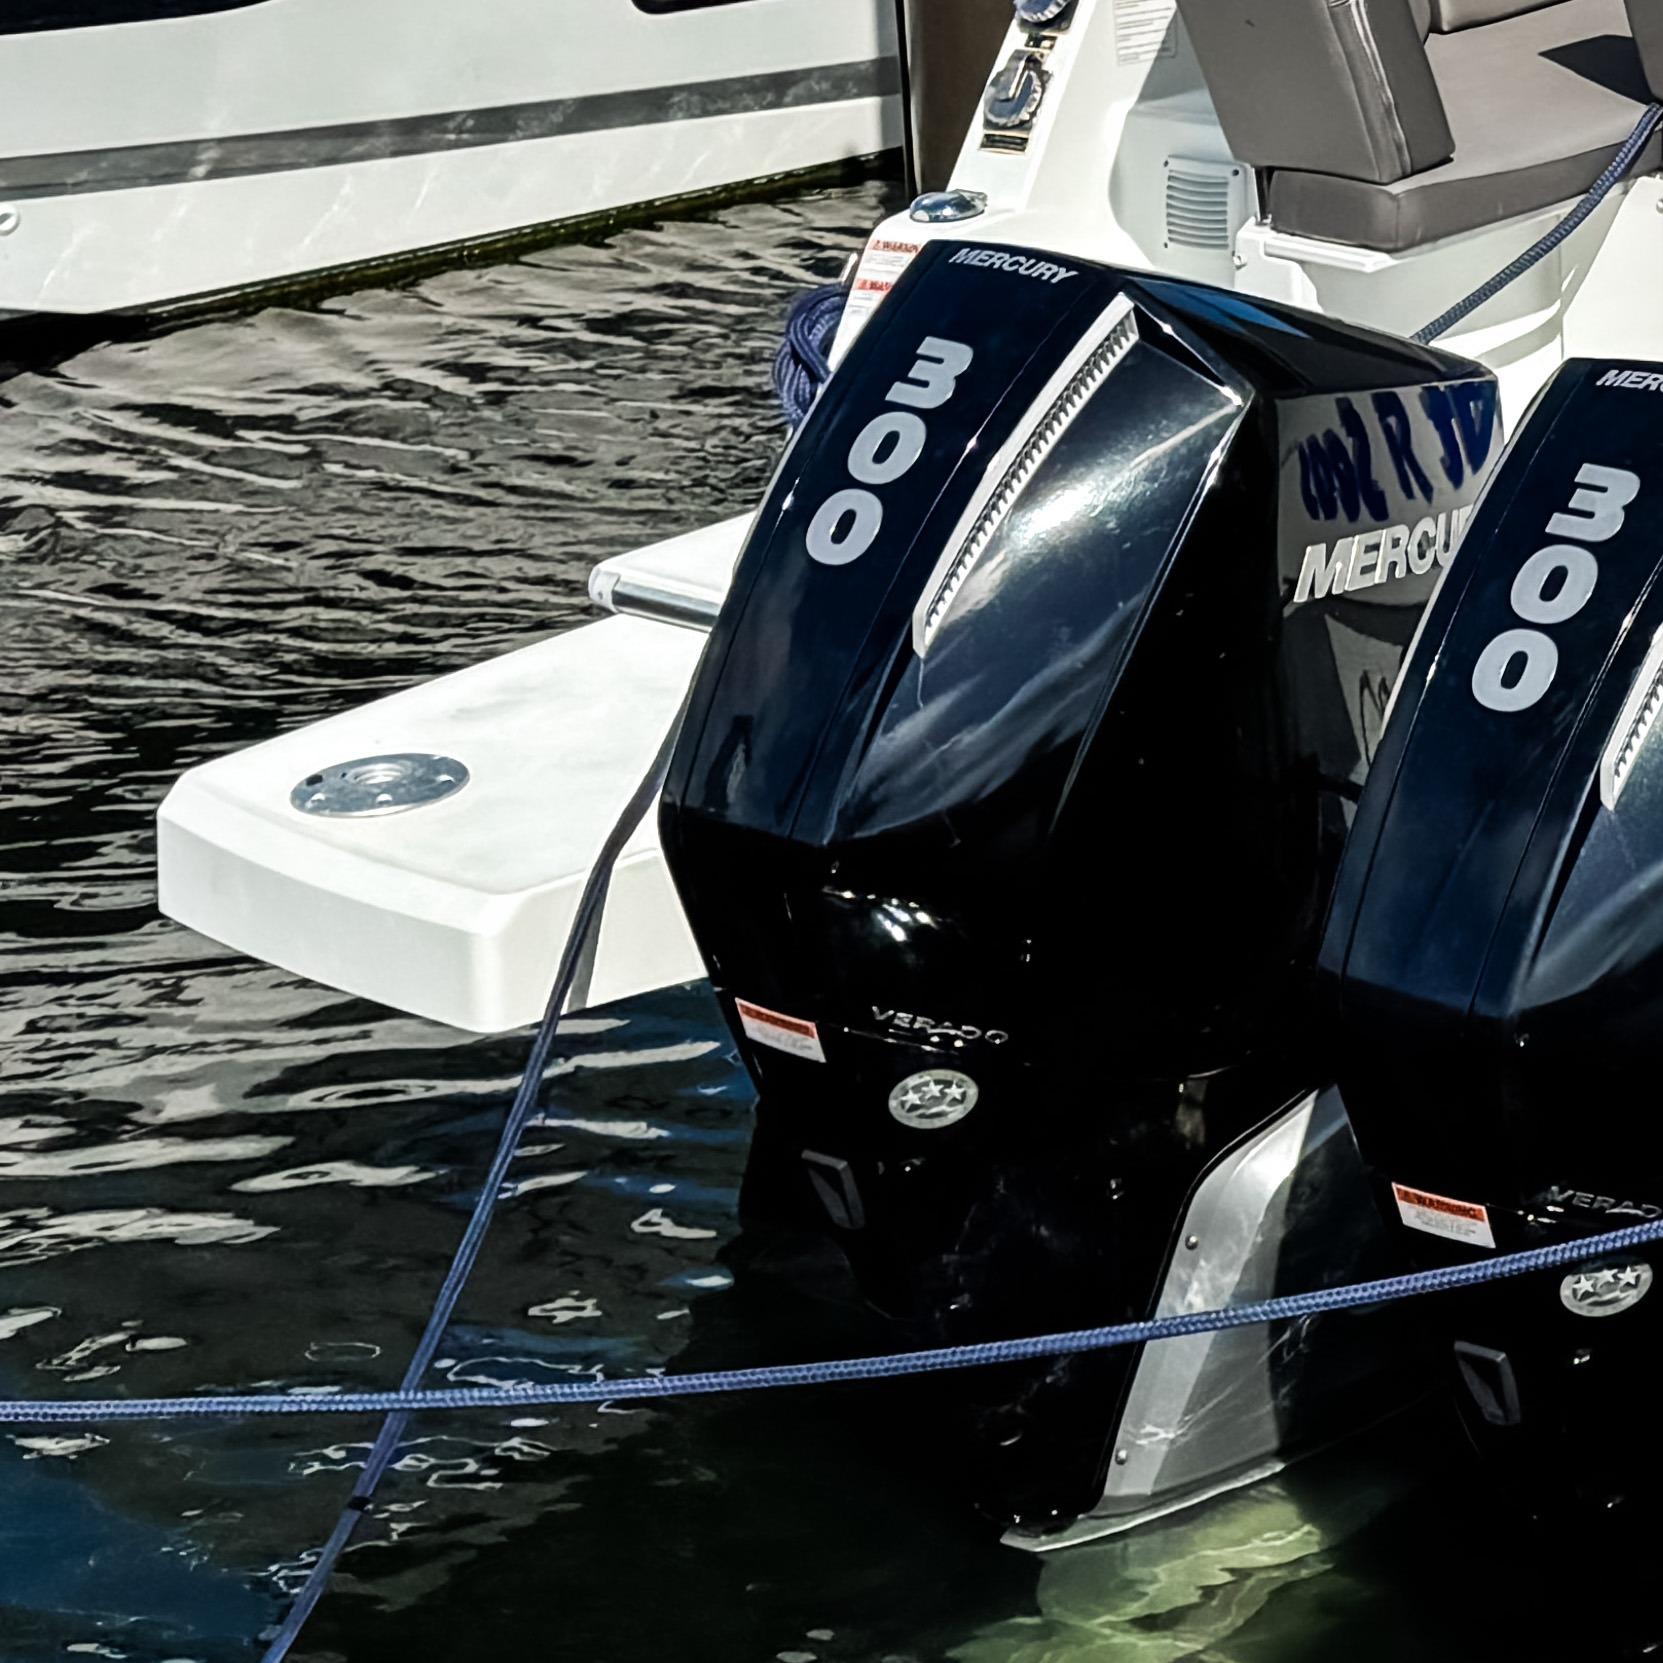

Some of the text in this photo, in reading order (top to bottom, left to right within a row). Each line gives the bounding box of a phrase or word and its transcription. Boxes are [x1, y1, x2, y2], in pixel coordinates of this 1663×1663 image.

[948, 247, 1080, 285] MERCURY
[805, 335, 975, 566] 300
[1293, 504, 1475, 603] MERCU
[1471, 462, 1642, 713] 300
